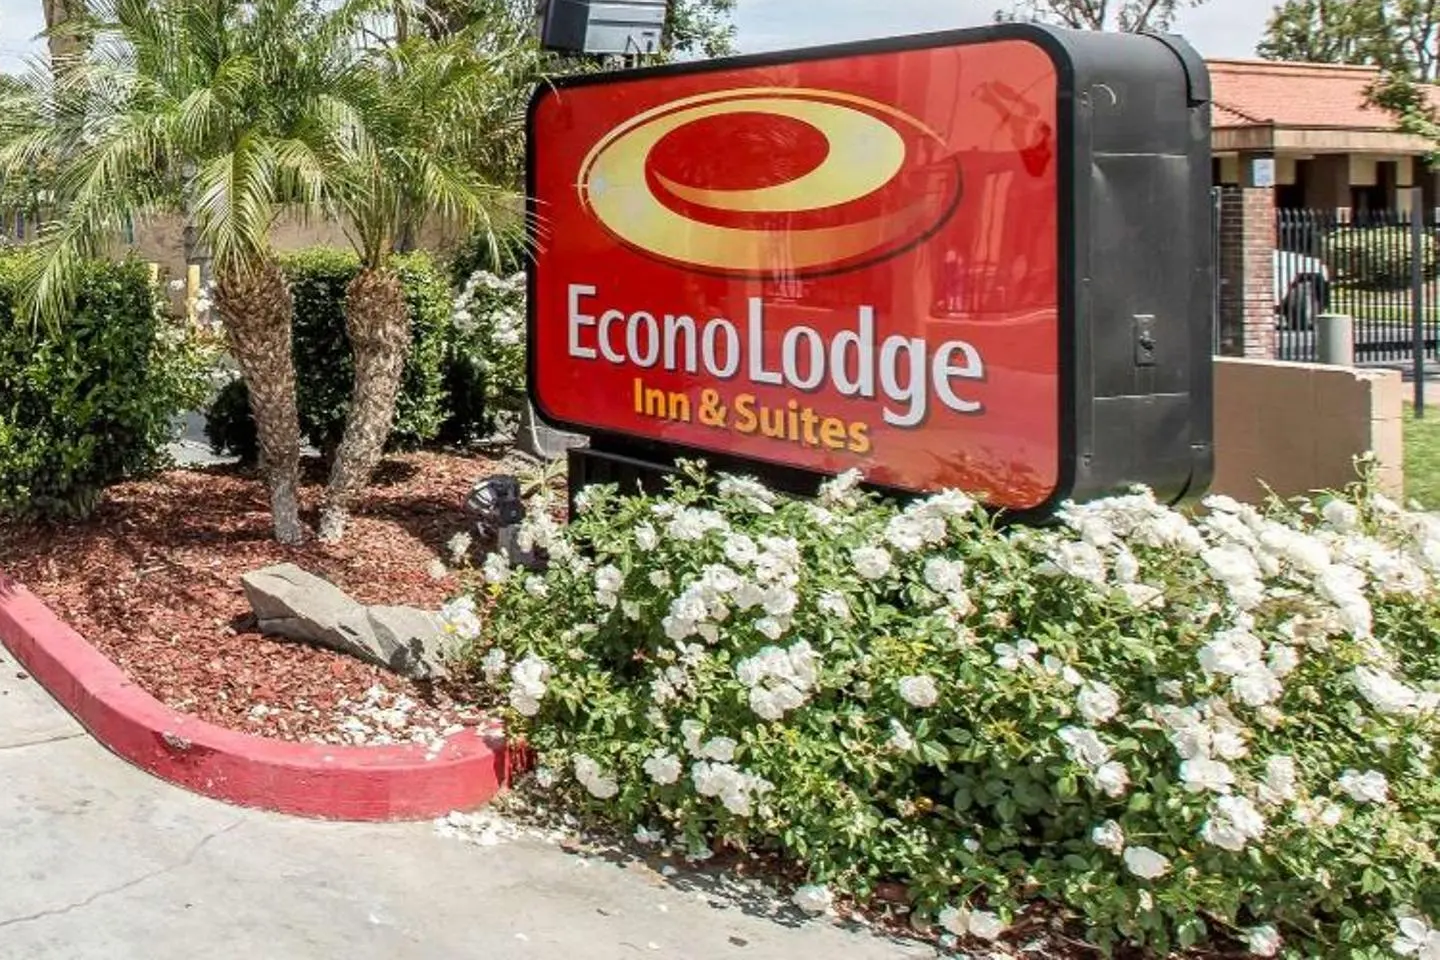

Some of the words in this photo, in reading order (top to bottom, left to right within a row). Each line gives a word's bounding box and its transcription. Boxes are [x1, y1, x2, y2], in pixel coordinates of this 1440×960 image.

[633, 377, 691, 422] Inn
[698, 388, 727, 427] &
[734, 393, 871, 453] Suites
